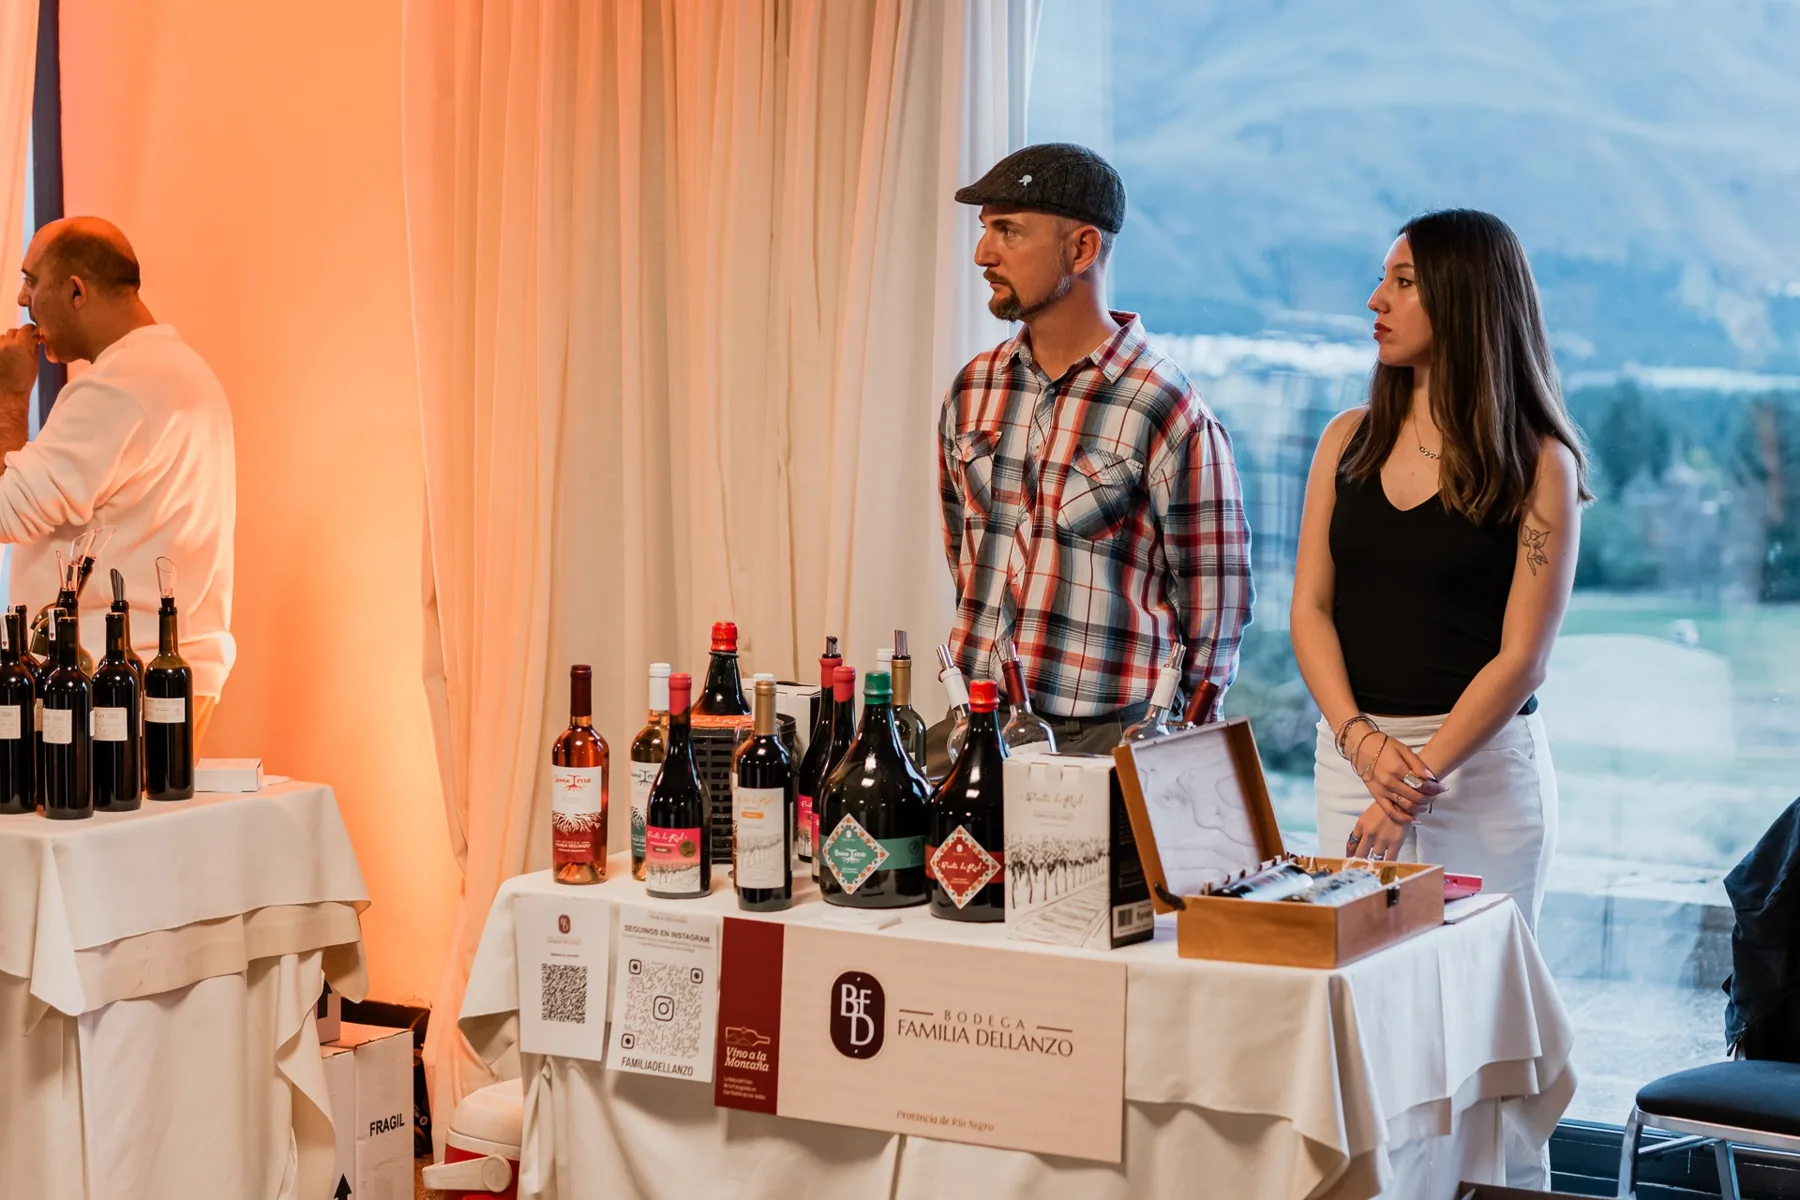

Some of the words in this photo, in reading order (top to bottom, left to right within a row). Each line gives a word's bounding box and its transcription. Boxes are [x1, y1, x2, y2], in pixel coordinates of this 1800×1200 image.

[624, 924, 659, 936] SEGUINOS
[660, 929, 670, 938] EN
[671, 931, 710, 943] INSTAGRAM
[944, 1009, 1025, 1030] BODEGA
[897, 1019, 970, 1045] FAMILIA
[975, 1028, 1074, 1057] DELLANZO
[726, 1046, 748, 1059] Vino
[748, 1051, 756, 1060] a
[756, 1051, 767, 1061] la
[621, 1056, 694, 1077] FAMILIADELLANZO
[724, 1056, 769, 1072] Montaña
[370, 1113, 405, 1137] FRAGIL
[939, 1115, 950, 1126] de
[968, 1119, 994, 1133] Negro
